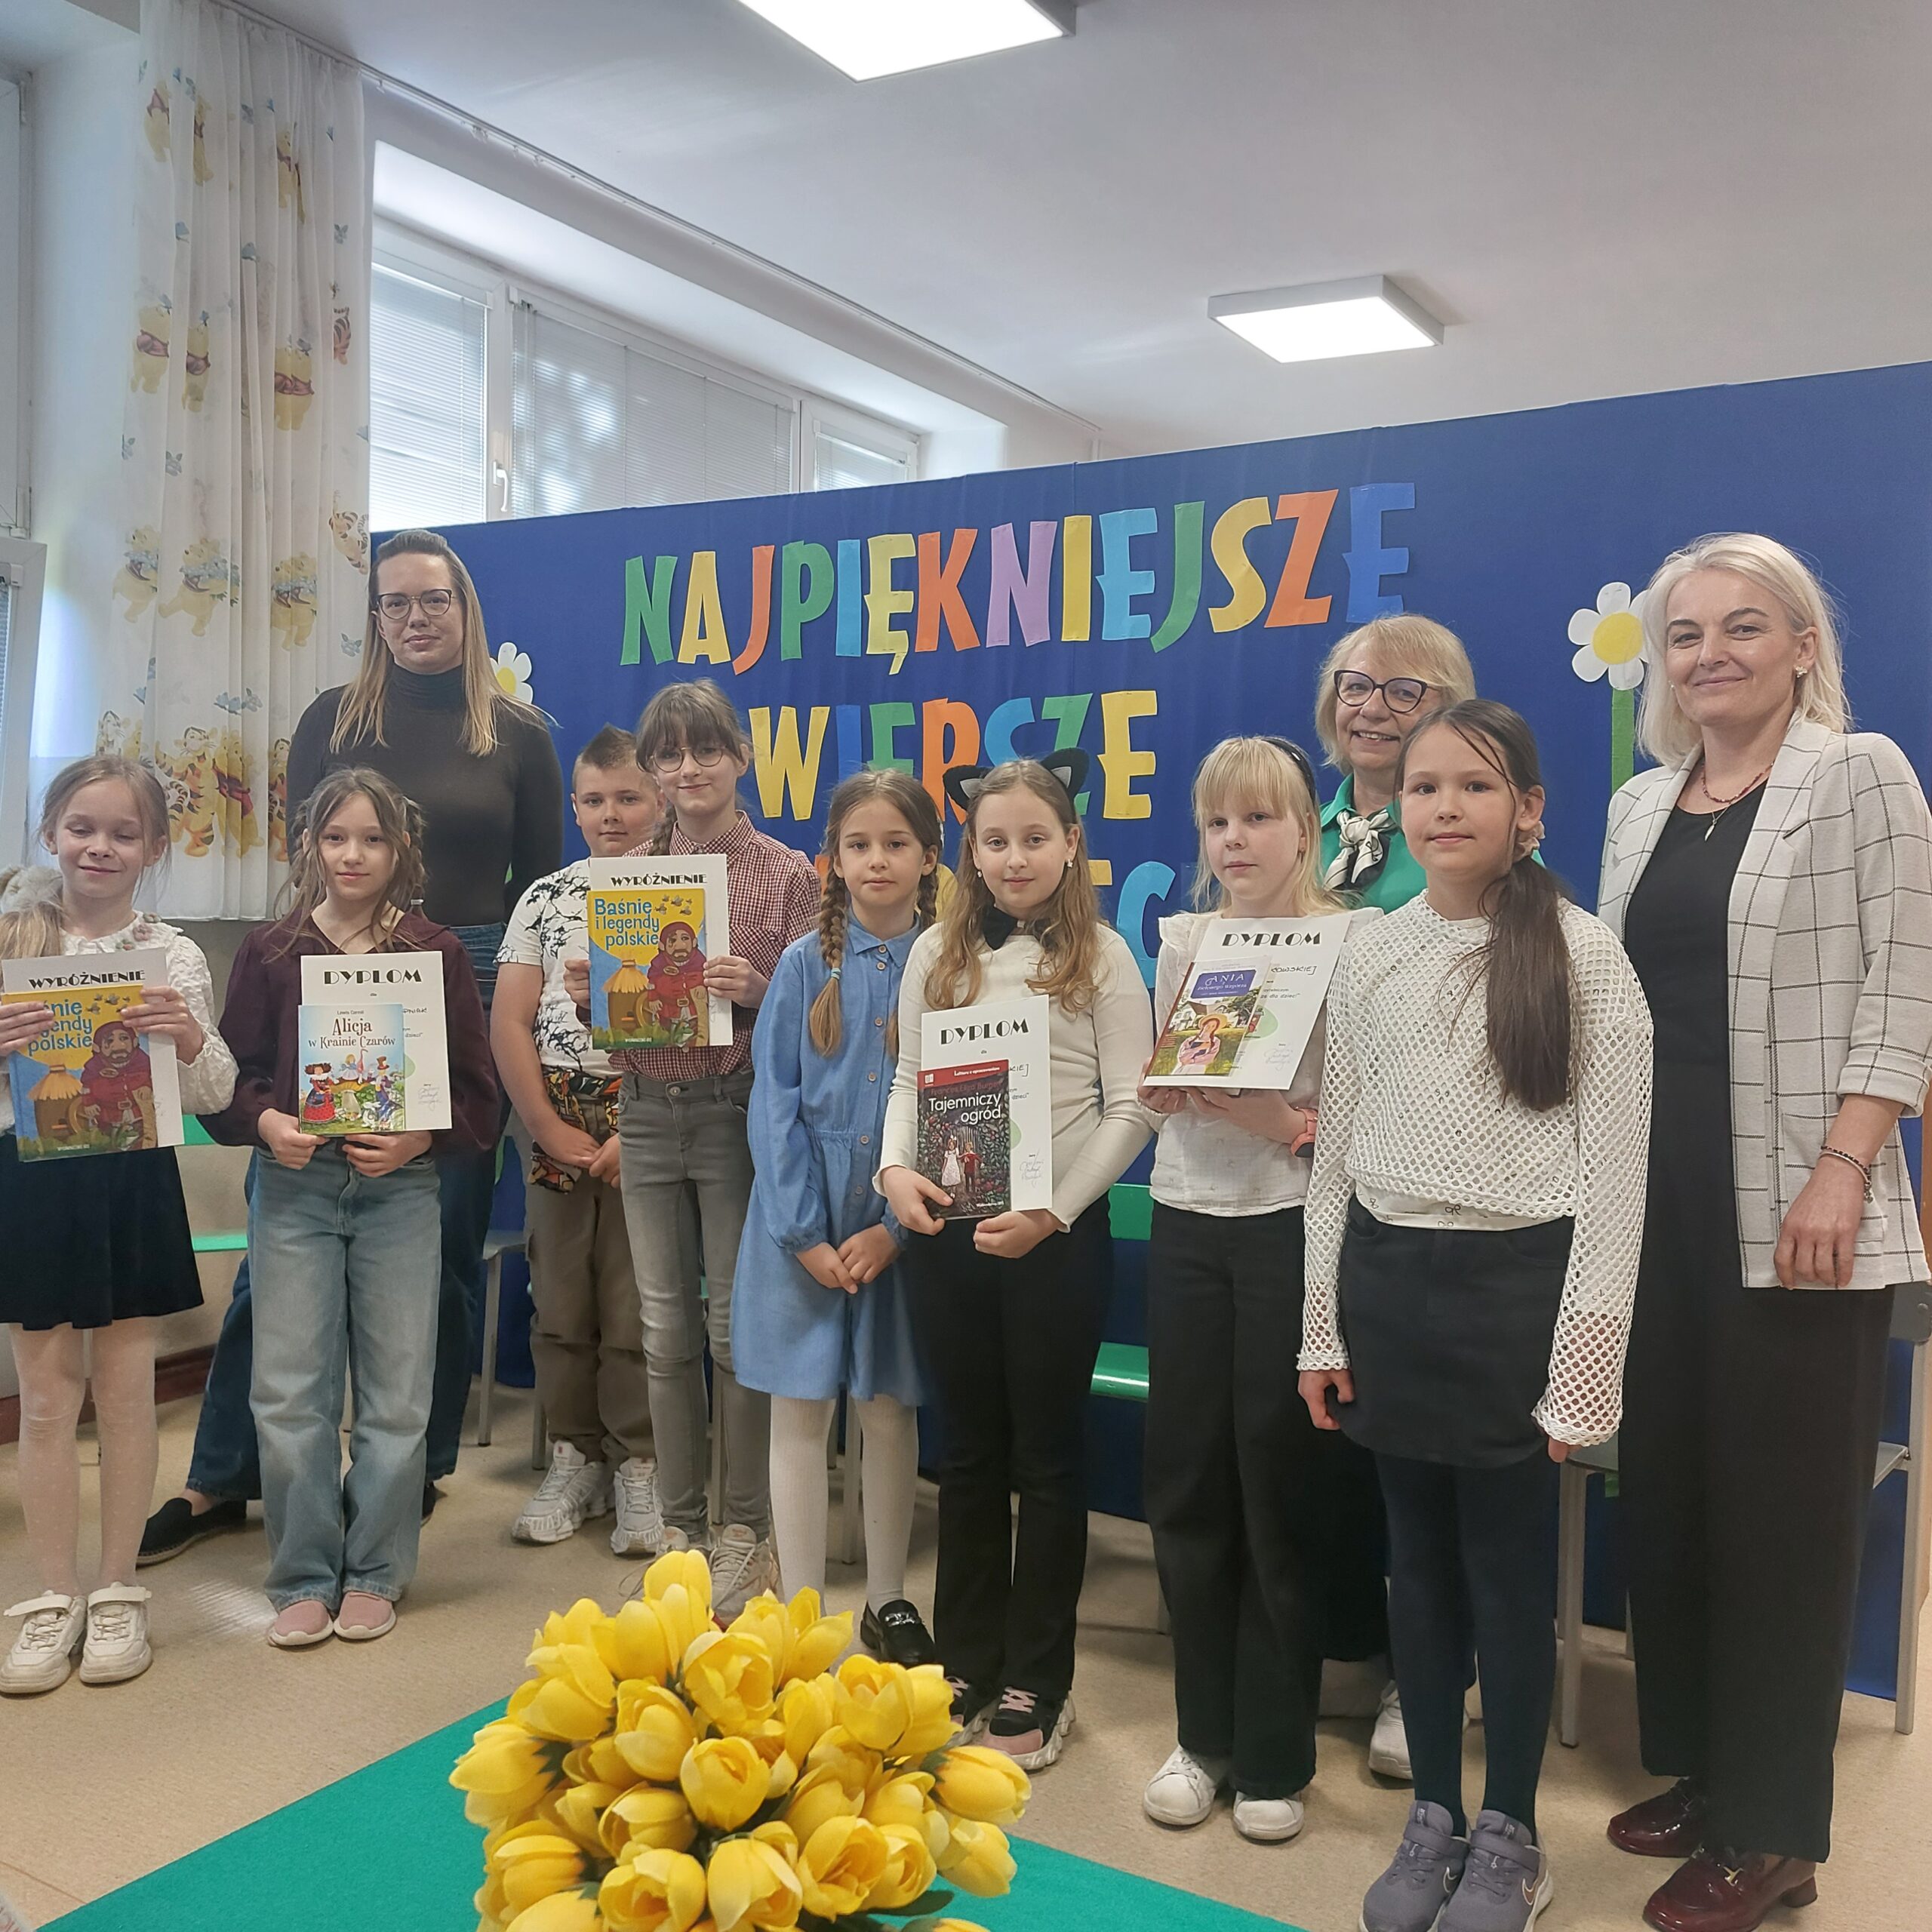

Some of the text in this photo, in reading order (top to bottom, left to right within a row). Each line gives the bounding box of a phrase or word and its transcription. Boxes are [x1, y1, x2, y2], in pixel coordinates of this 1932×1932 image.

[620, 482, 1415, 675] NAJPIĘKNIEJSZE
[611, 872, 707, 887] WYRÓŻNIENIE
[594, 898, 653, 915] Baśnie
[595, 913, 660, 934] i legendy
[605, 931, 659, 951] polskie
[1222, 931, 1321, 947] DYPLOM
[29, 970, 146, 989] WYRÓŻNIENIE
[325, 969, 422, 985] DYPLOM
[1204, 973, 1244, 986] ANIA
[332, 1017, 373, 1036] Alicja
[940, 1018, 1029, 1045] DYPLOM
[28, 1033, 93, 1057] polskie
[308, 1035, 395, 1049] w Krainie Czarów
[928, 1092, 1001, 1114] Tajemniczy
[961, 1104, 1001, 1125] ogród
